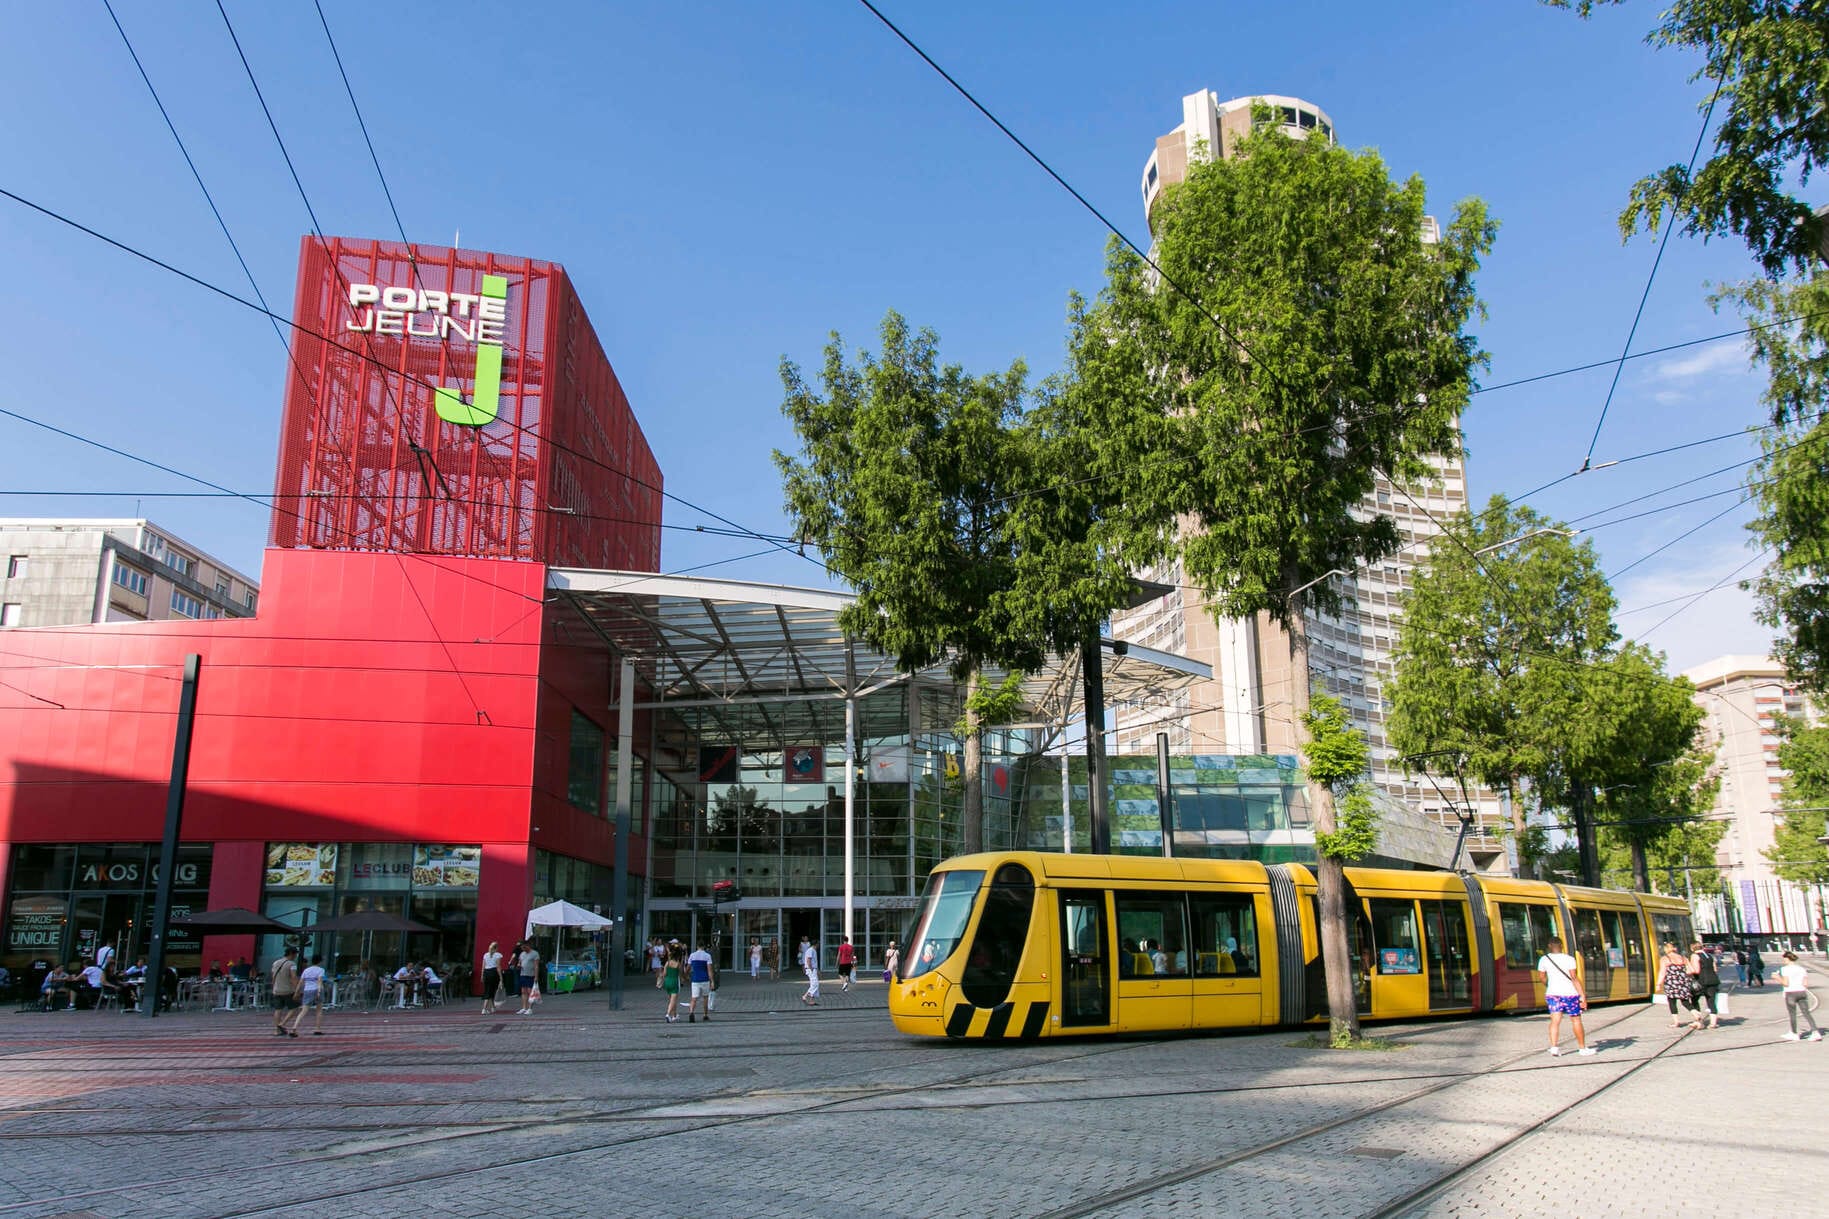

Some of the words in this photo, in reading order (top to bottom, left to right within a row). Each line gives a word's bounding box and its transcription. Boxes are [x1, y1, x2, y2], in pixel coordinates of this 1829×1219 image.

[349, 283, 507, 321] PORTE
[346, 308, 506, 345] JEUNE
[82, 863, 139, 883] AKOS
[11, 932, 60, 945] UNIQUE
